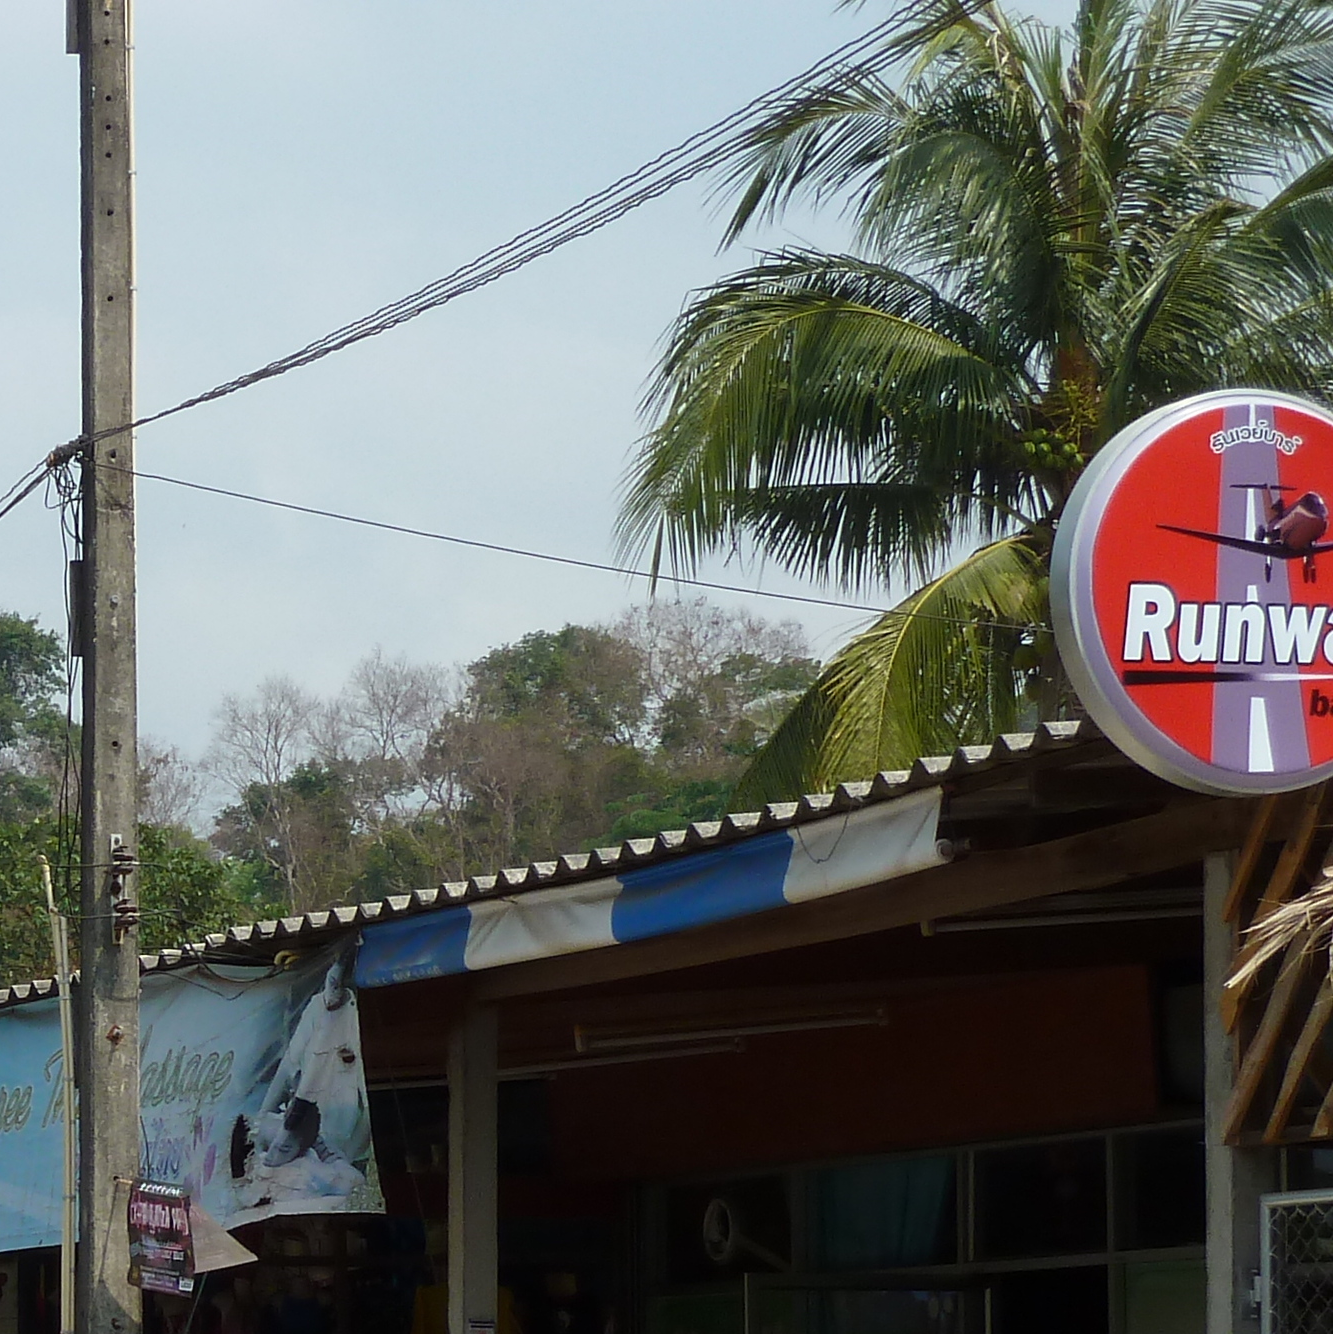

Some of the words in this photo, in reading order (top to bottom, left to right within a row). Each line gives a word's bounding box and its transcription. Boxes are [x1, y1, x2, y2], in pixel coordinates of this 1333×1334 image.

[1210, 420, 1304, 455] รันเวย์บาร์
[1309, 689, 1333, 717] b
[139, 1030, 236, 1110] assage
